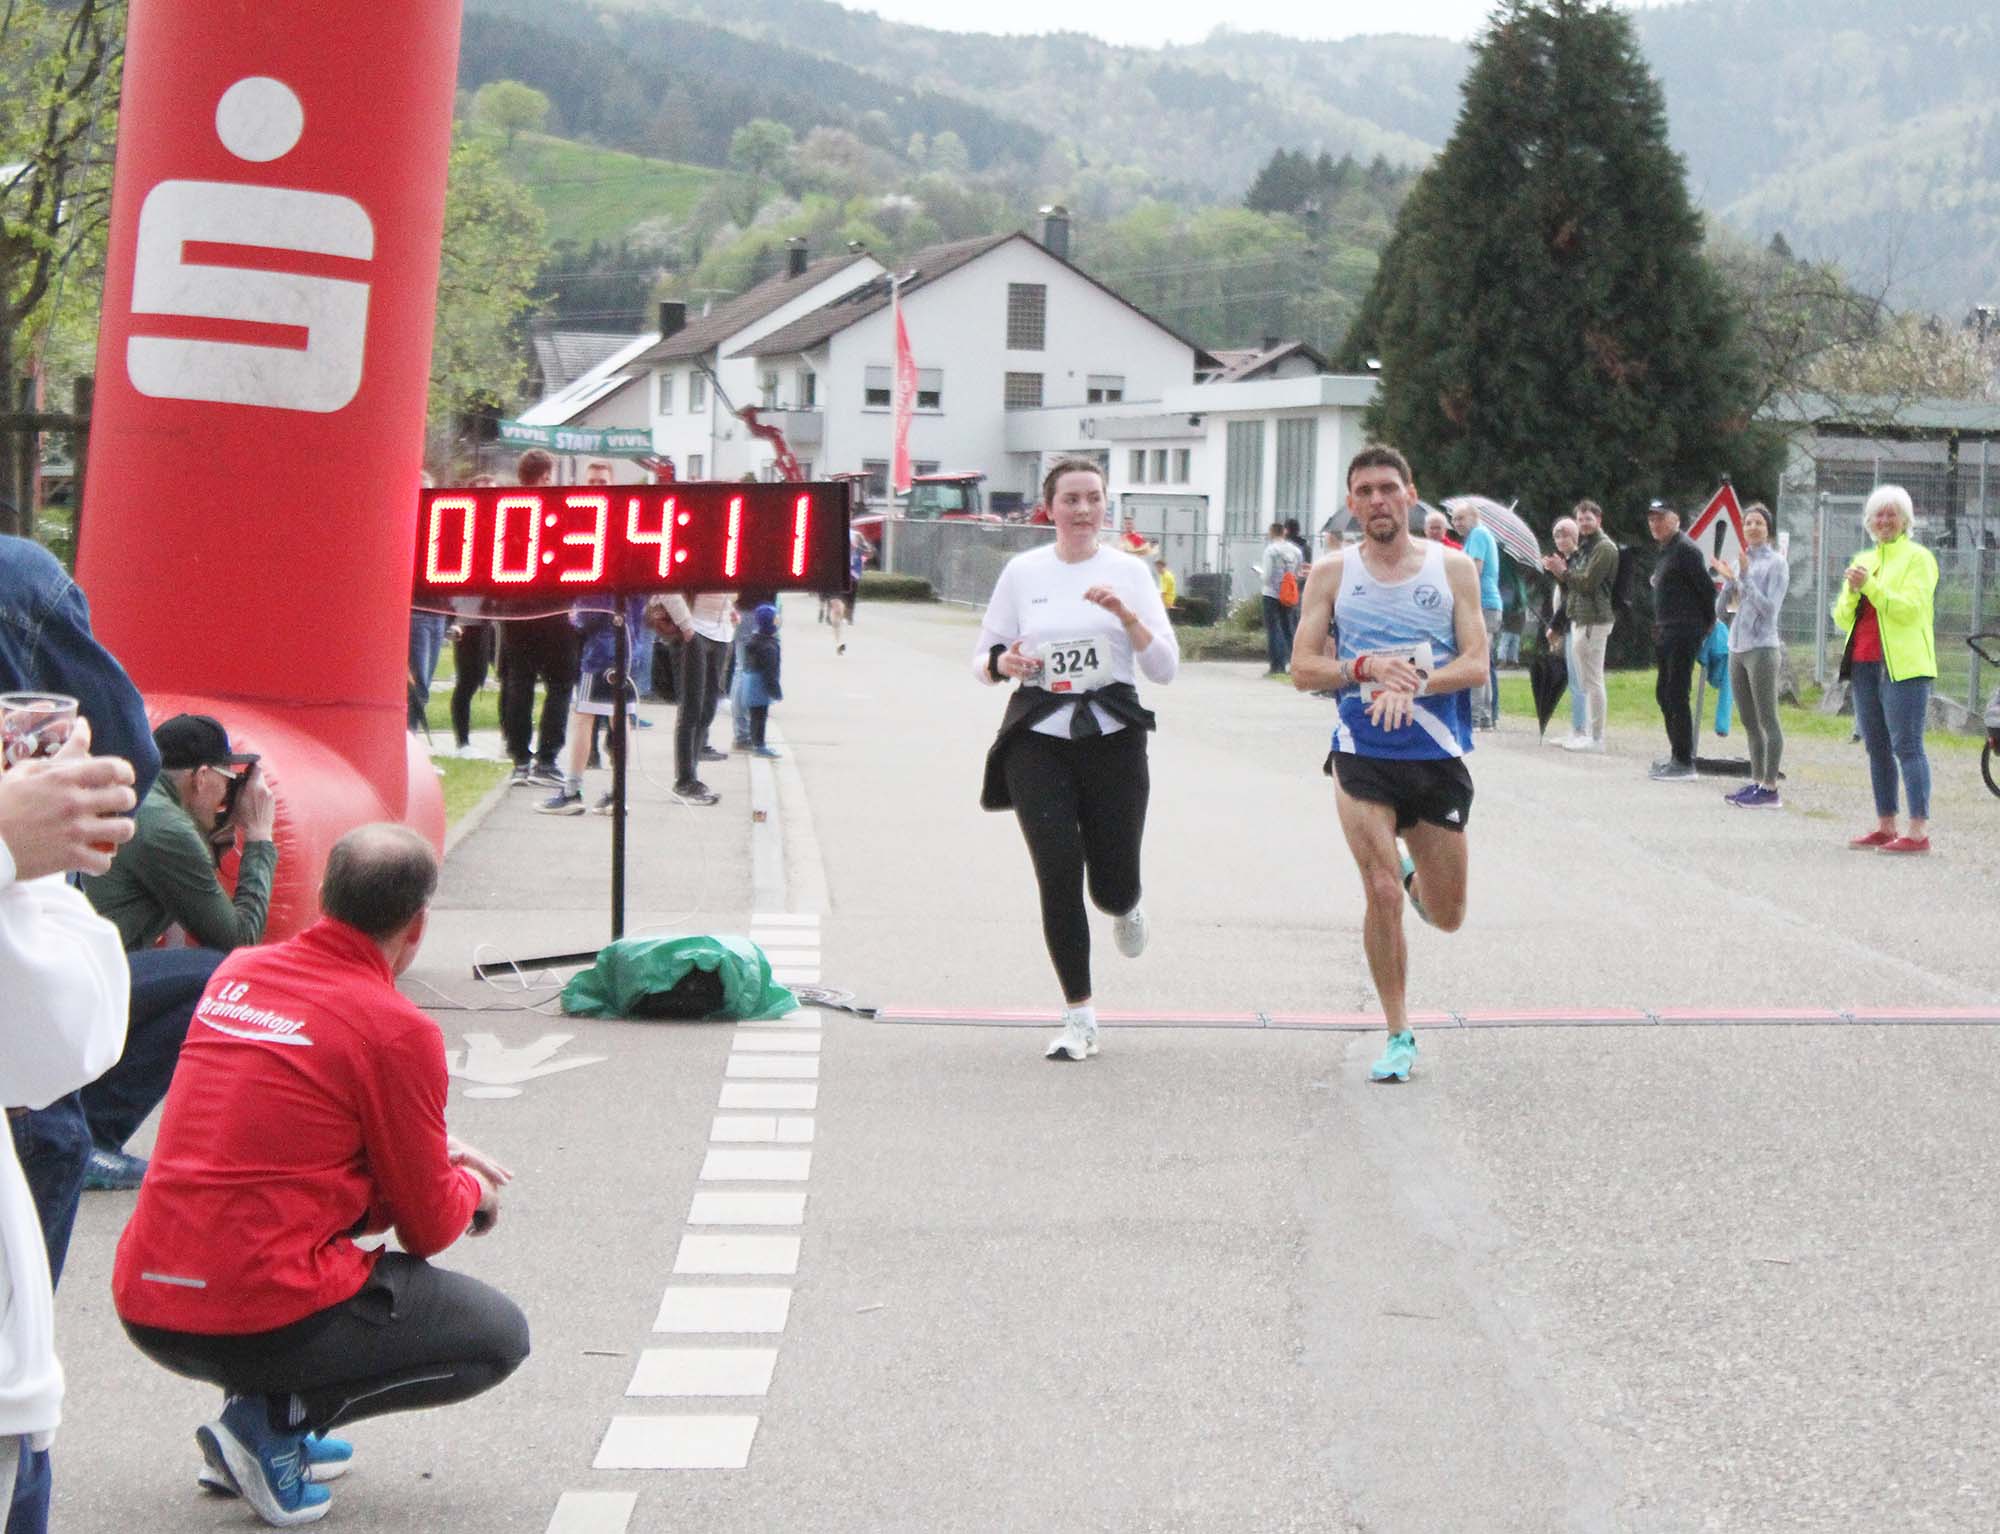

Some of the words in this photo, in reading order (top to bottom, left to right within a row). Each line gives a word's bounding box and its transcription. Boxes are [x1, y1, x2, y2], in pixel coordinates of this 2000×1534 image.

[555, 432, 602, 450] START
[1051, 648, 1099, 674] 324
[218, 980, 249, 1001] LG
[198, 997, 305, 1035] Brandenkopf
